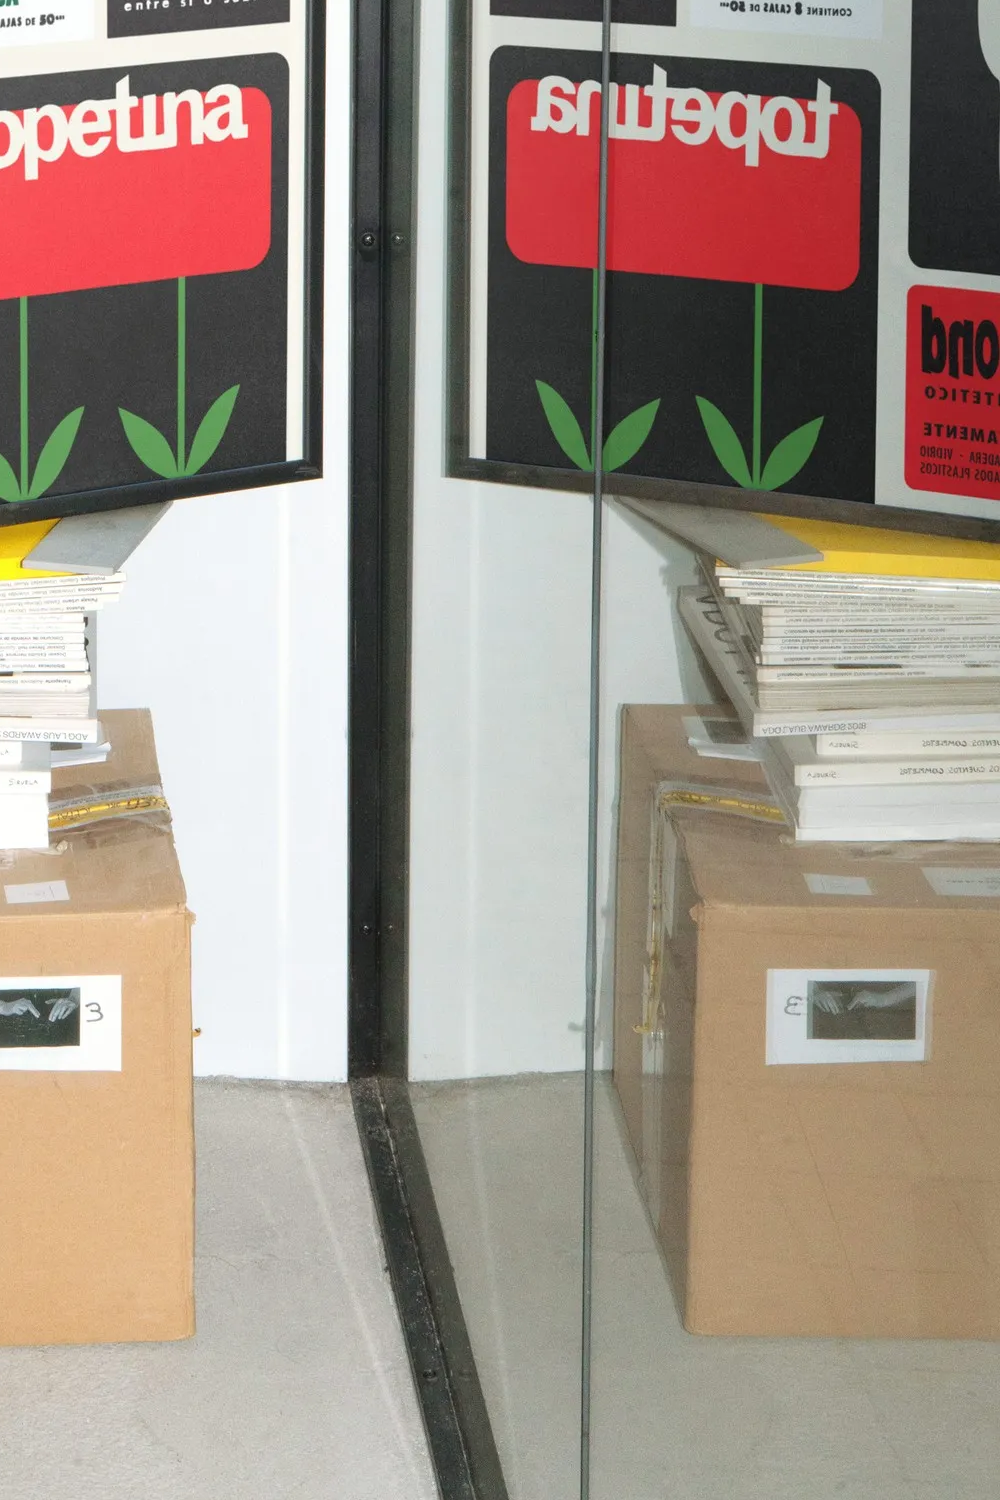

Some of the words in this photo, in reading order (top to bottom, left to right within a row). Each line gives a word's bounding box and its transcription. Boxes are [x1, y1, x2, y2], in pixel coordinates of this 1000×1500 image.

[124, 0, 170, 12] entre
[25, 17, 36, 26] DE
[3, 731, 41, 739] AWARDS
[44, 732, 67, 740] LAUS
[85, 1002, 104, 1023] 3
